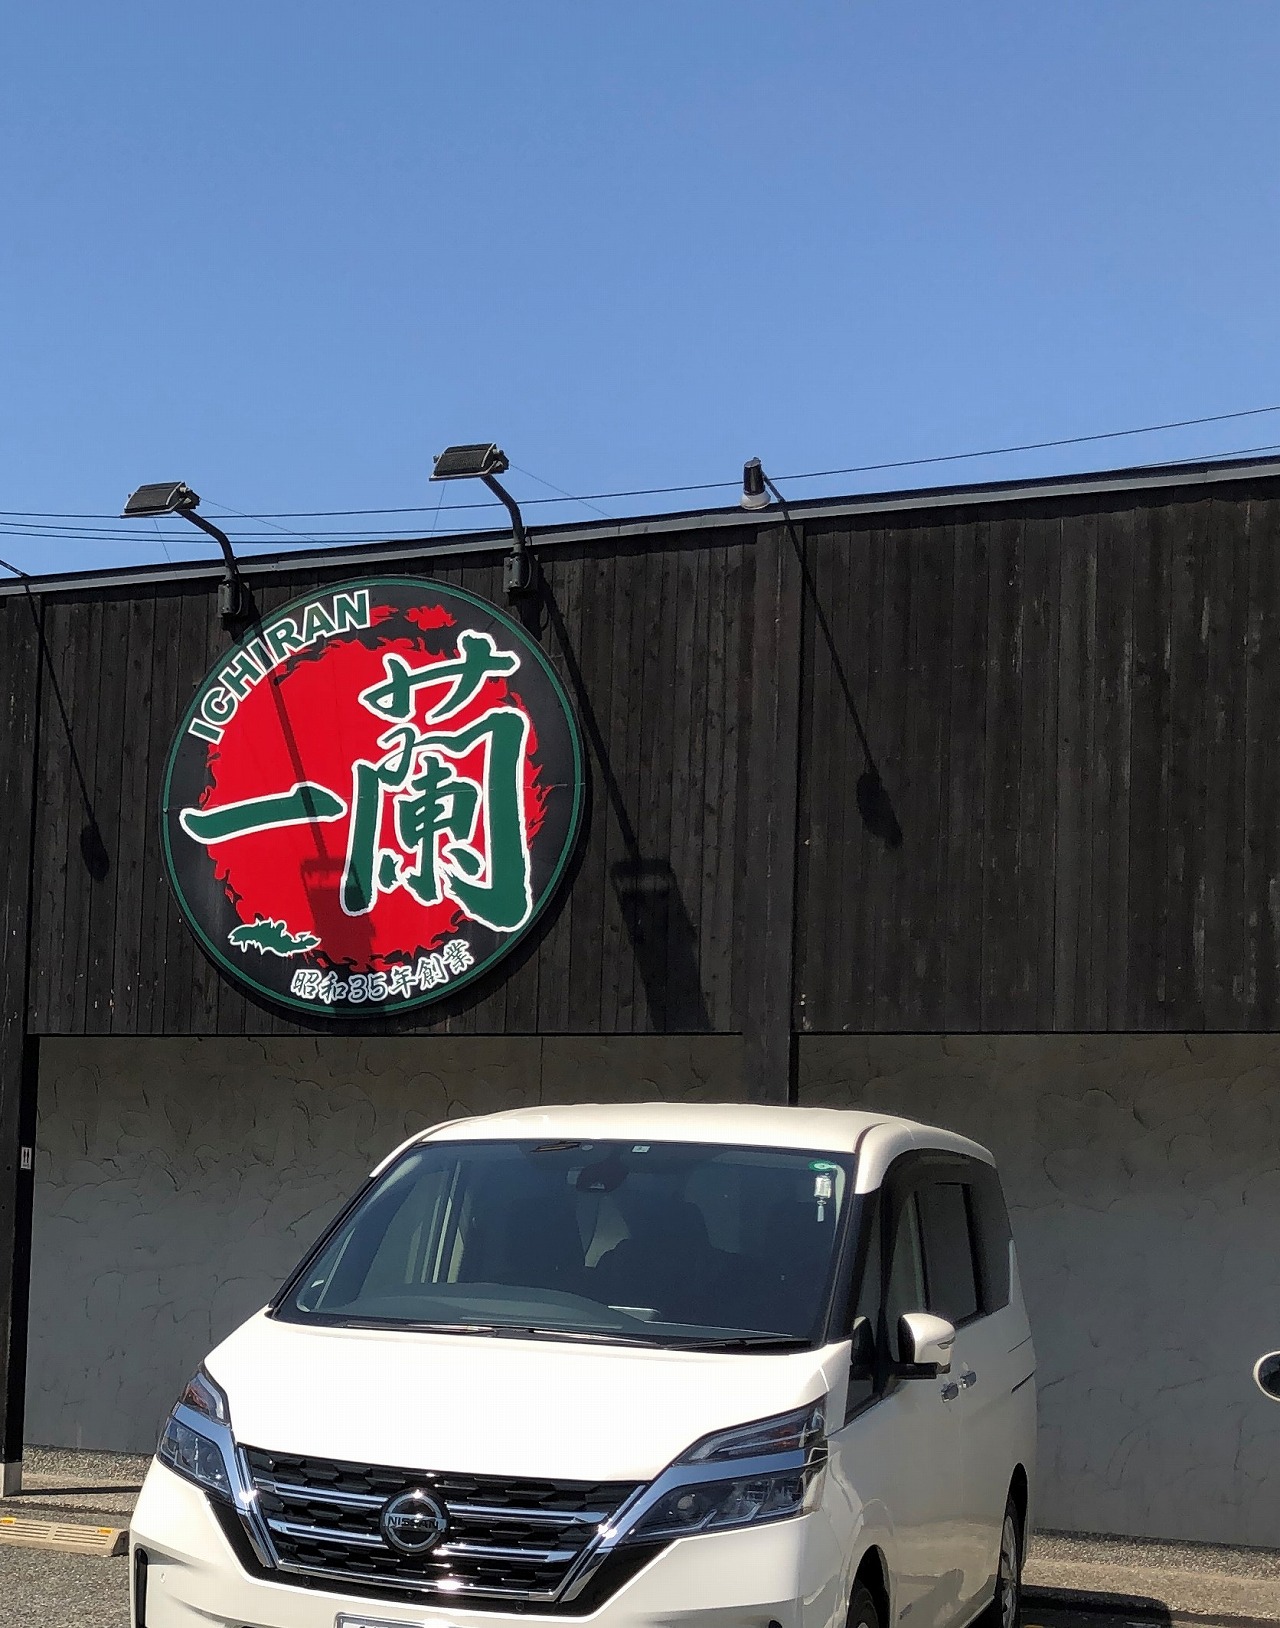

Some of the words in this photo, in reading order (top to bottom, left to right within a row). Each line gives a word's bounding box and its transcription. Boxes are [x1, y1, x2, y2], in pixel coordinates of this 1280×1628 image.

[188, 589, 370, 745] ICHIRAN
[179, 629, 533, 932] 一蘭
[290, 939, 475, 1004] 昭和35年創業
